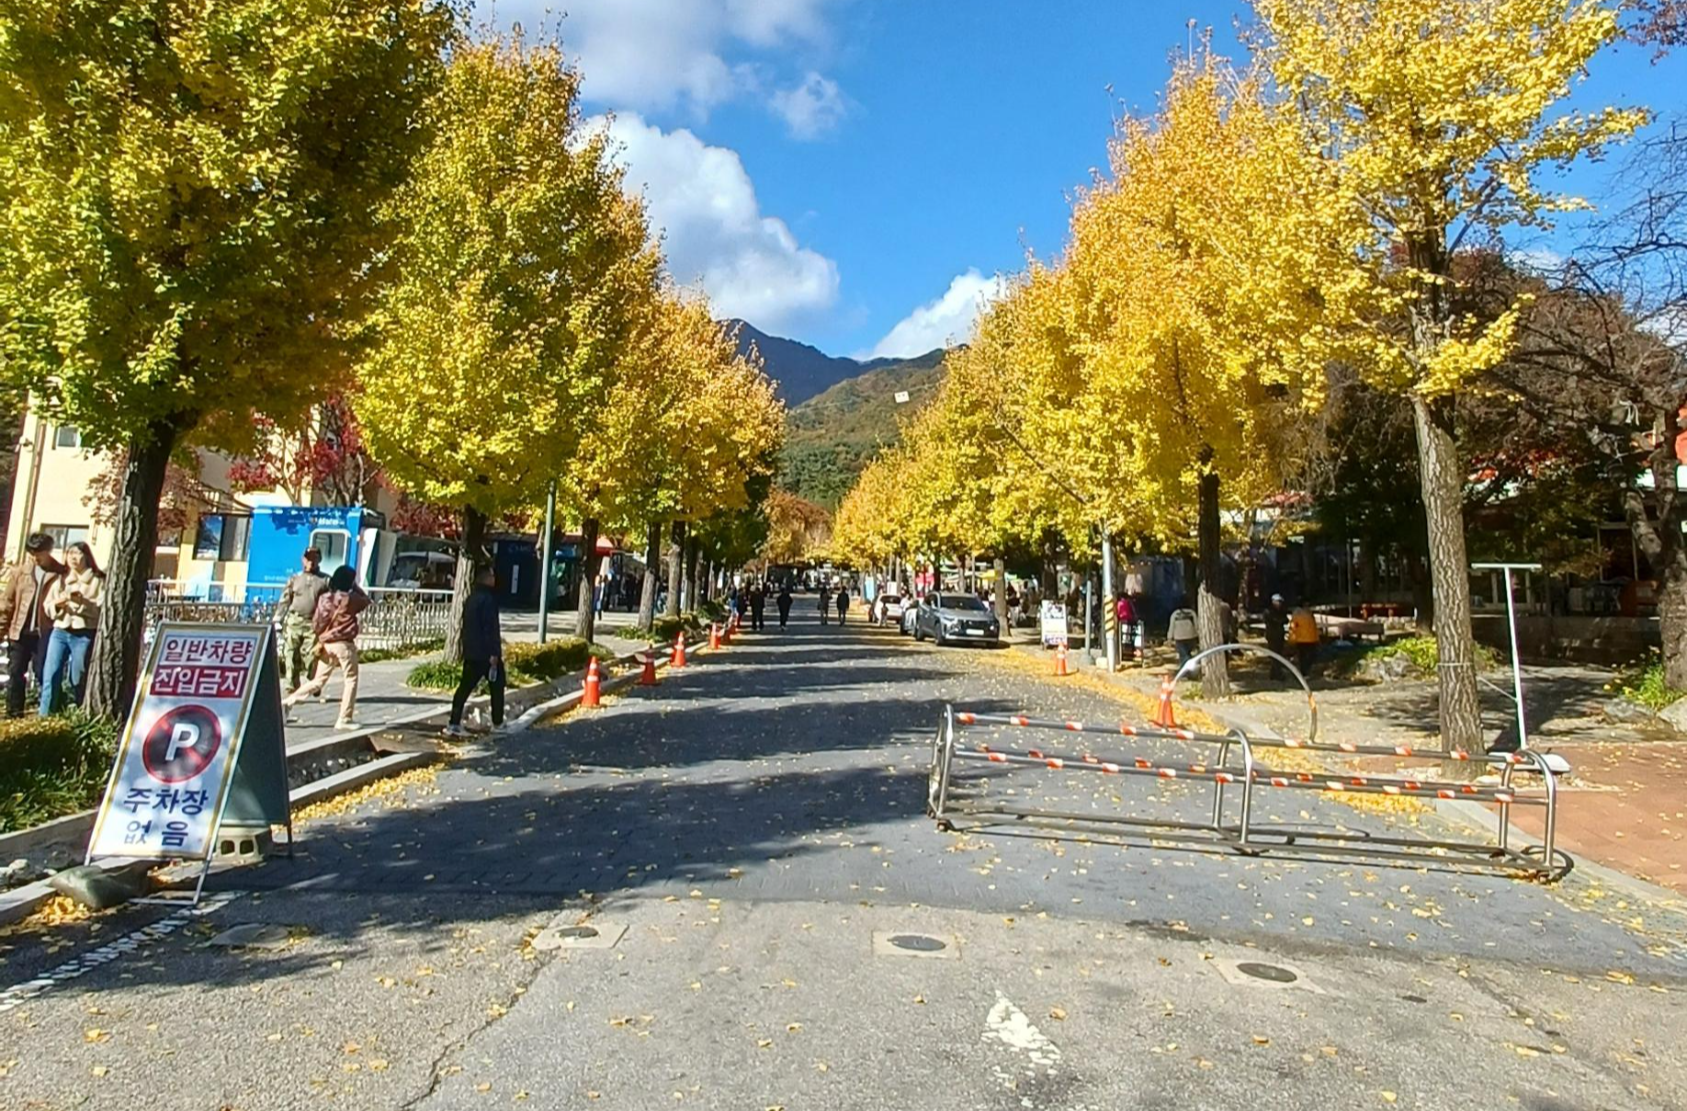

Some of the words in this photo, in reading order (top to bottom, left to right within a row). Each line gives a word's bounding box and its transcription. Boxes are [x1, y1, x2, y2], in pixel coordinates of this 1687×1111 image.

[164, 639, 253, 664] 일반차량
[155, 668, 244, 696] 진입금지
[165, 723, 199, 761] P
[123, 788, 208, 815] 주차장
